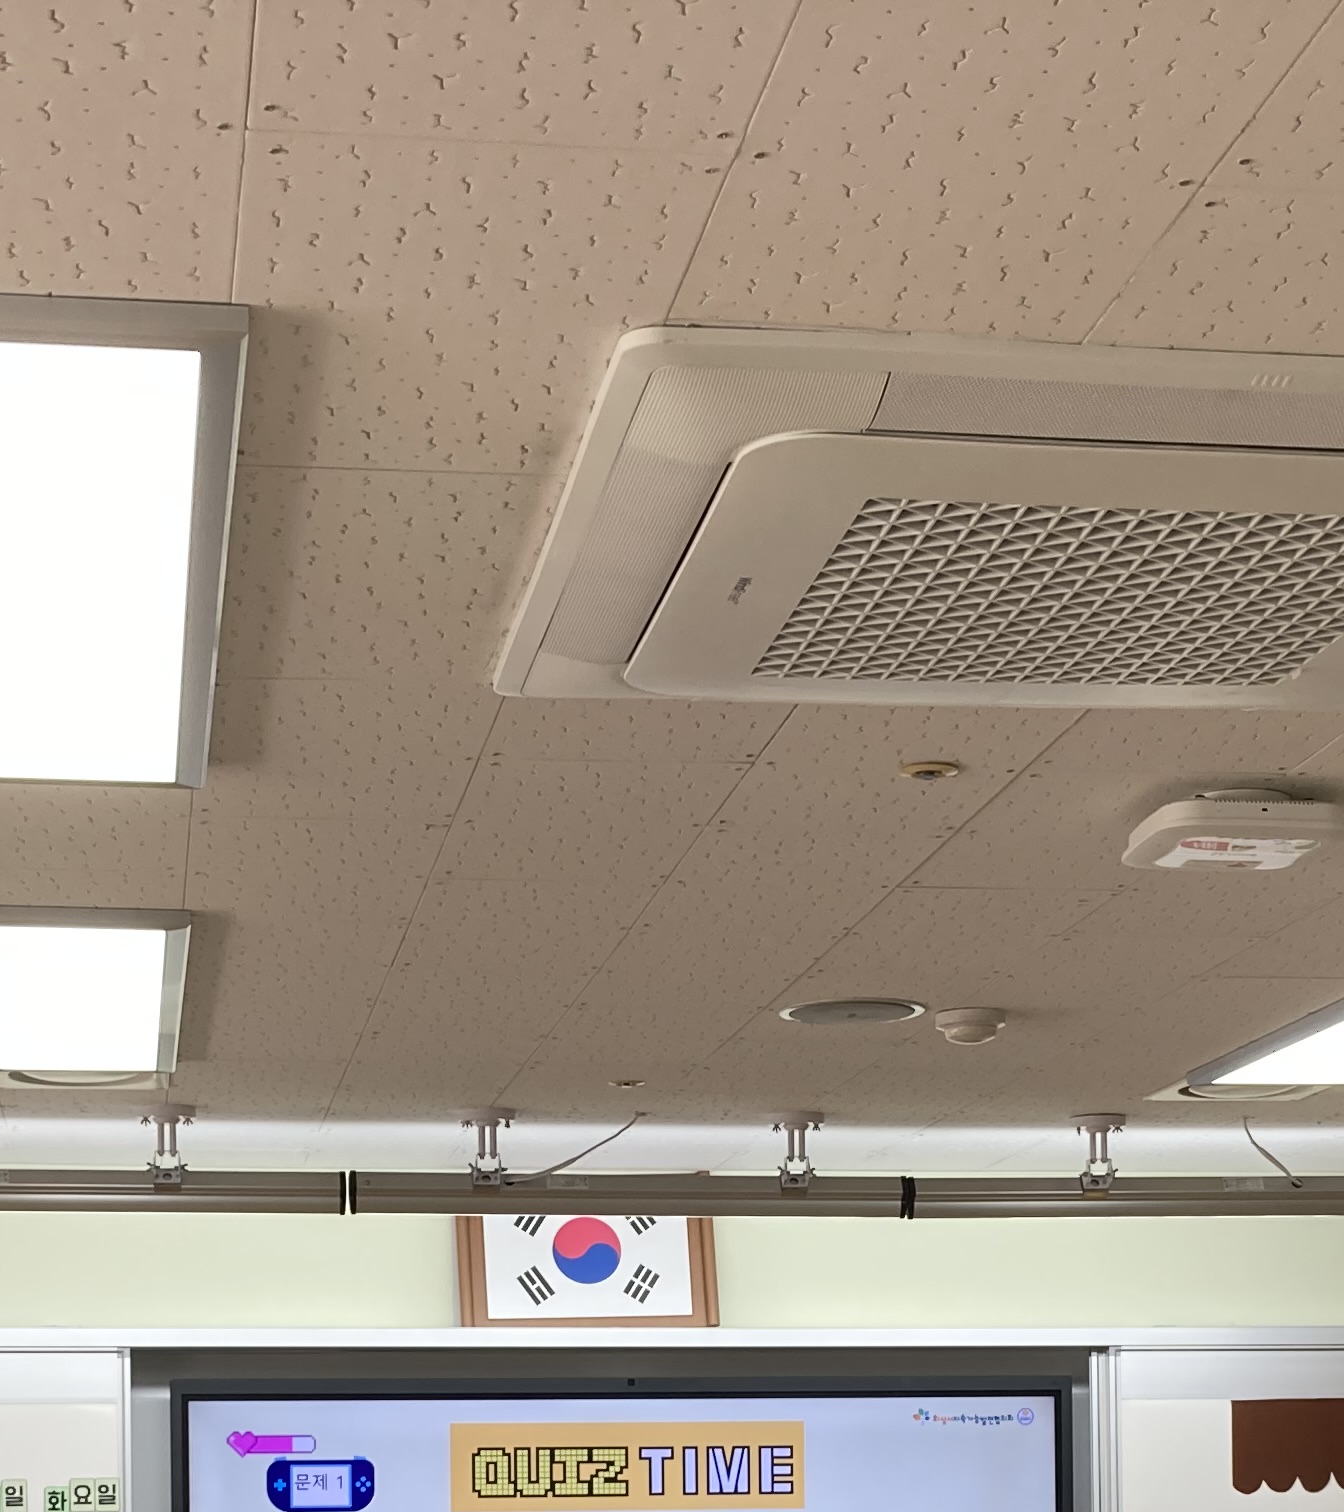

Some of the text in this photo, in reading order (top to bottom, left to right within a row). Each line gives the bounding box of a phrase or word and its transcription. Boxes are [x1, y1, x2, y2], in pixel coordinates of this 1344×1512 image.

[294, 1472, 344, 1491] 문제 1
[472, 1445, 794, 1498] QUIZ TIME
[47, 1484, 116, 1511] 화요일
